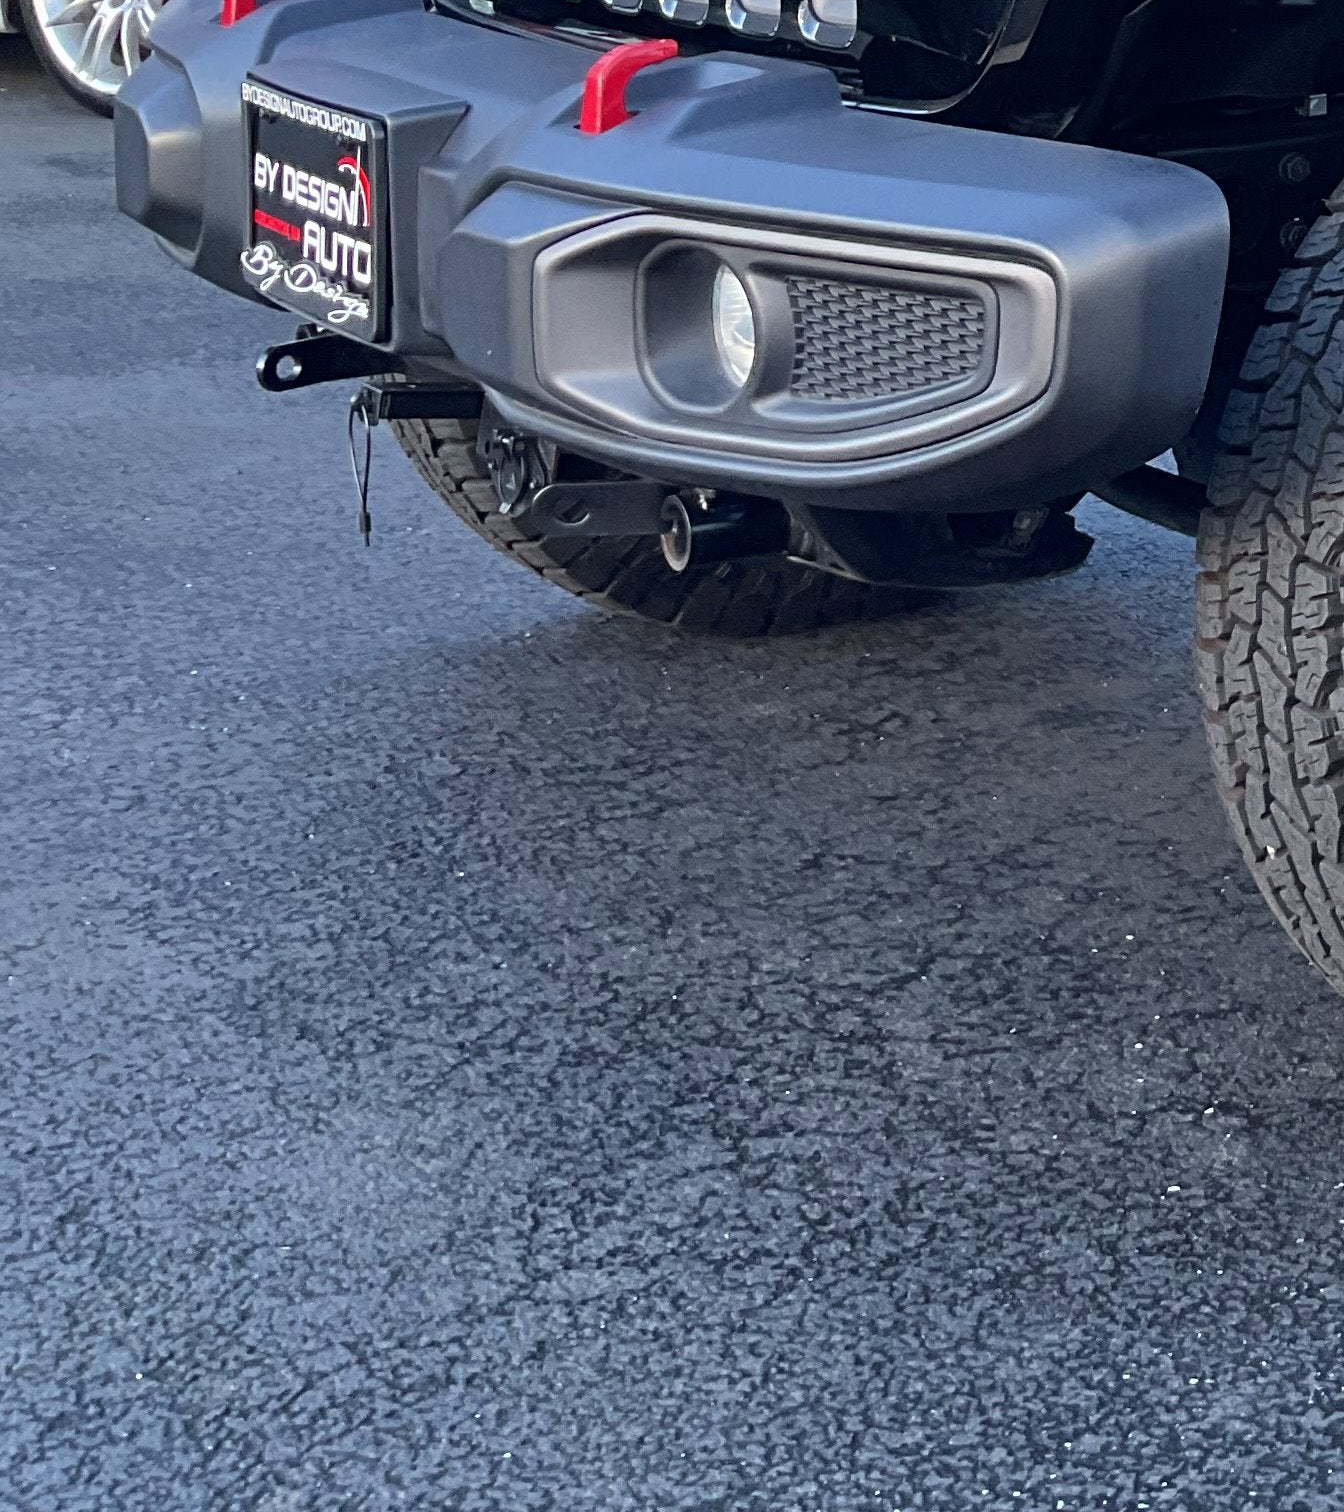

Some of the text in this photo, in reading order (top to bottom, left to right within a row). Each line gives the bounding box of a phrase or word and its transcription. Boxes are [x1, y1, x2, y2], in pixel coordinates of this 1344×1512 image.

[253, 152, 280, 193] BY
[282, 165, 360, 226] DESIGN
[241, 244, 284, 291] By
[303, 220, 371, 284] AUTO
